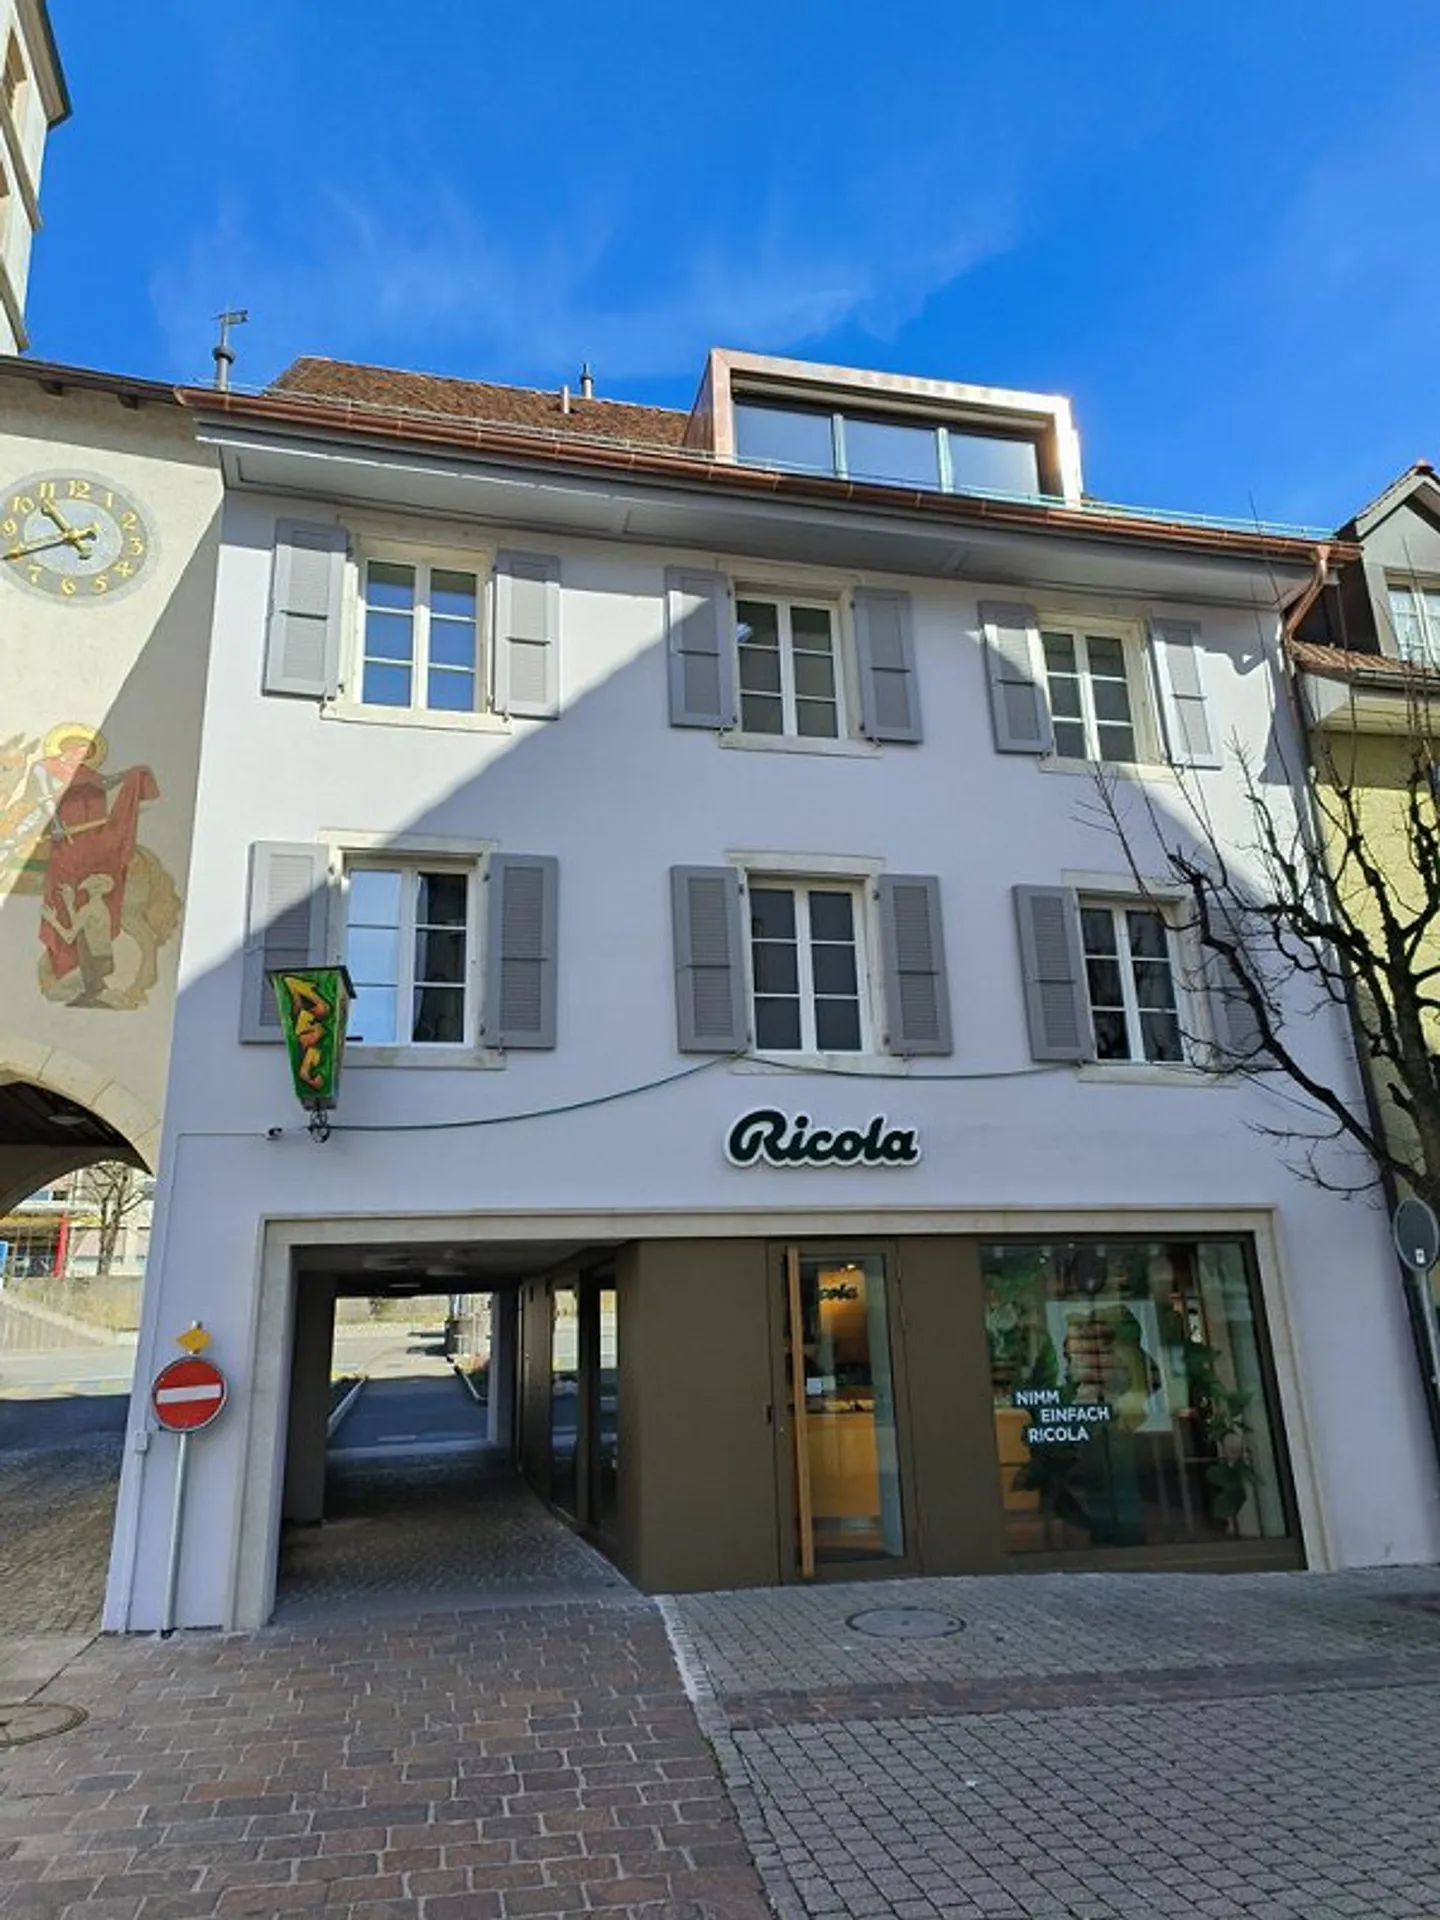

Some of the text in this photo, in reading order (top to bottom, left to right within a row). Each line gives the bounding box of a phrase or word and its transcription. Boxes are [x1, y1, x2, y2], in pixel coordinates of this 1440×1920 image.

[39, 482, 56, 498] 11
[68, 480, 90, 499] 12
[12, 496, 35, 514] 10
[105, 492, 114, 508] 1
[2, 518, 17, 536] 9
[122, 512, 137, 530] 2
[130, 538, 143, 556] 3
[28, 564, 43, 583] 7
[113, 561, 133, 577] 4
[61, 578, 76, 595] 6
[94, 575, 108, 592] 5
[727, 1108, 920, 1163] Ricola
[1015, 1389, 1060, 1406] NIMM
[1041, 1406, 1110, 1423] EINFACH
[1027, 1426, 1090, 1443] RICOLA
